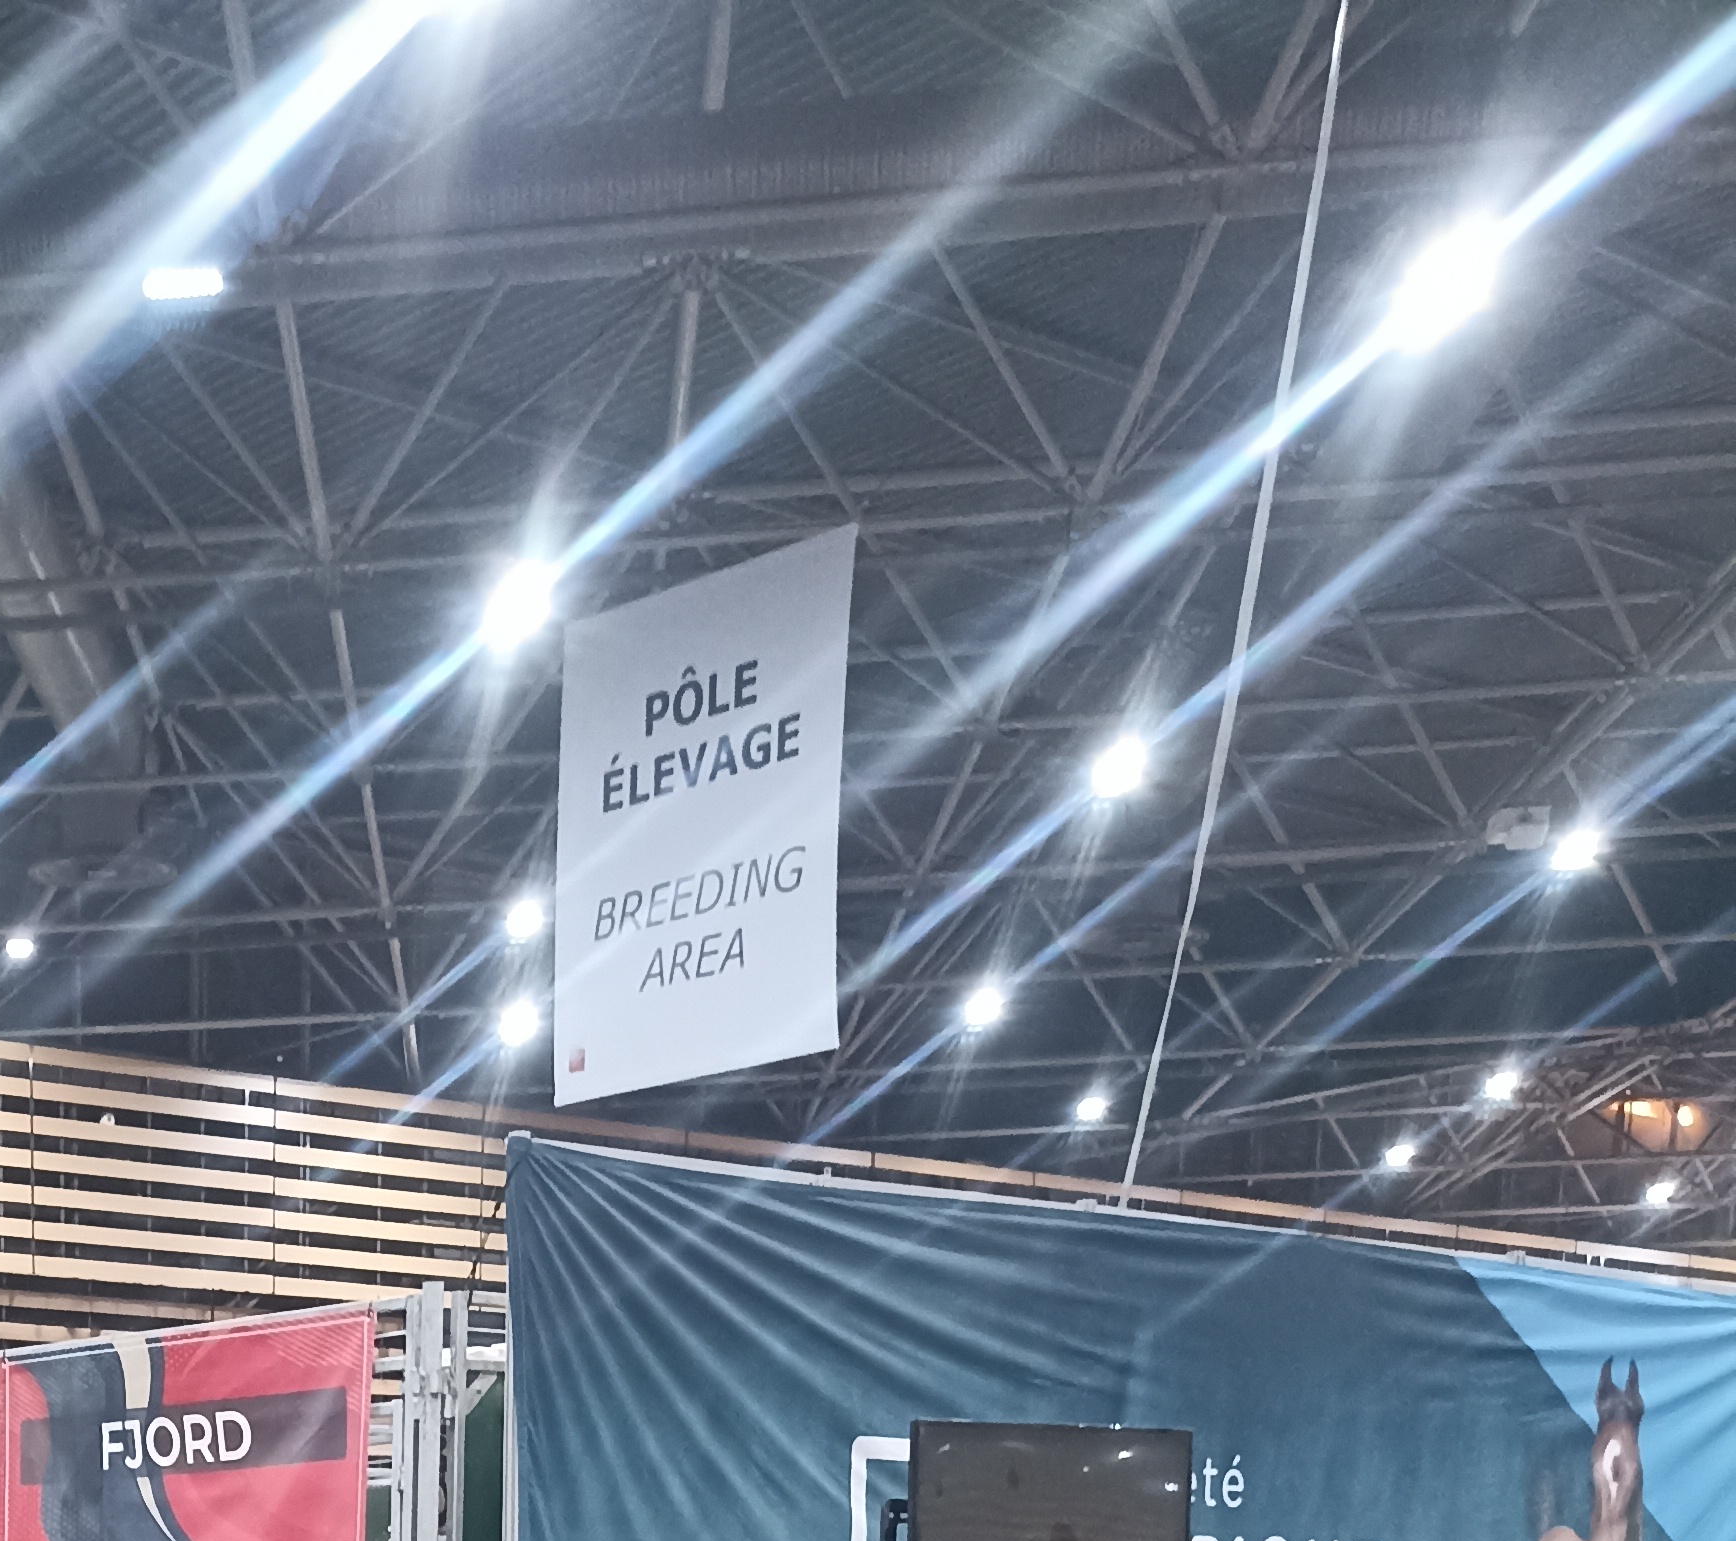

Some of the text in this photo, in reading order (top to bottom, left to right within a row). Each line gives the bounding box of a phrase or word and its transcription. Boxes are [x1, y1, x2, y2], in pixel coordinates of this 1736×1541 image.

[644, 659, 759, 737] PÔLE
[602, 712, 800, 813] ÉLEVAGE
[594, 846, 806, 941] BREEDING
[638, 928, 745, 992] AREA
[101, 1410, 252, 1470] FJORD
[1191, 1455, 1244, 1508] té
